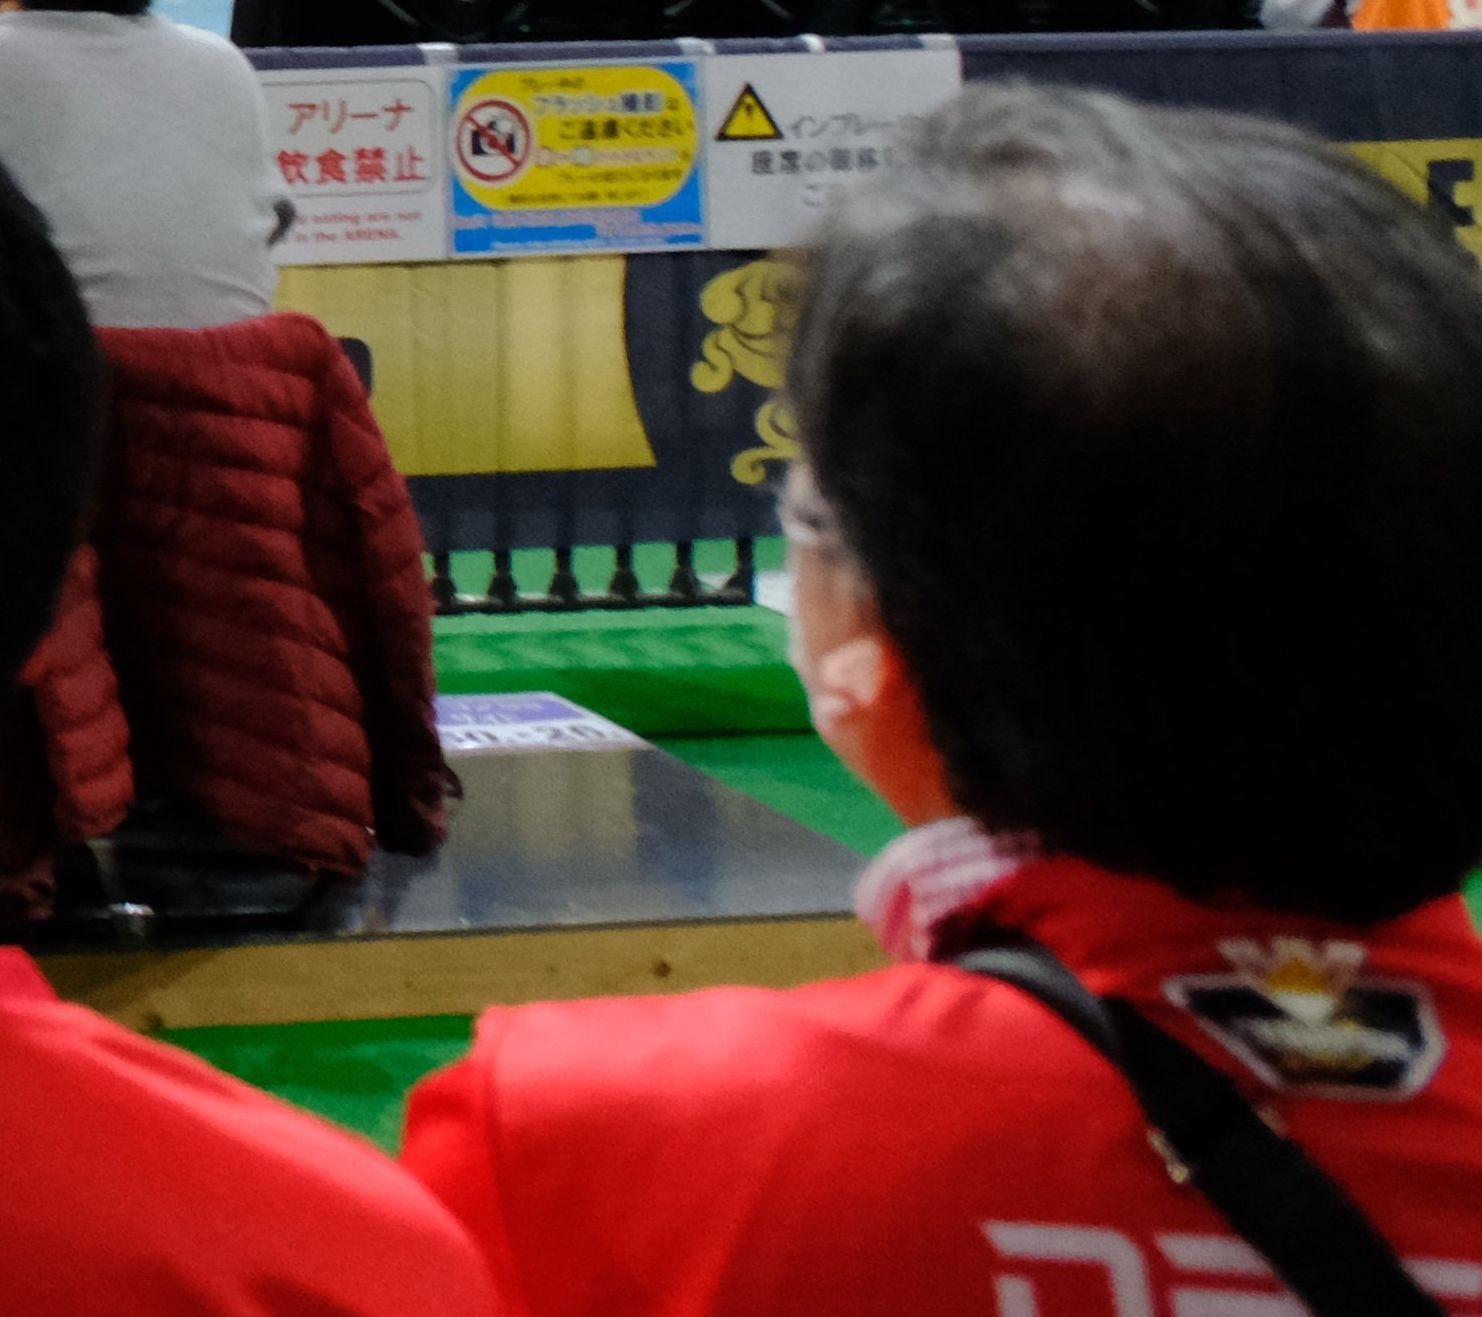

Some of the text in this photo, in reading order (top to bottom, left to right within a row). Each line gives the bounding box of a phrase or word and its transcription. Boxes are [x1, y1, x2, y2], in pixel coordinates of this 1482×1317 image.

[289, 98, 412, 135] アリーナ
[276, 145, 429, 184] 飲食禁止
